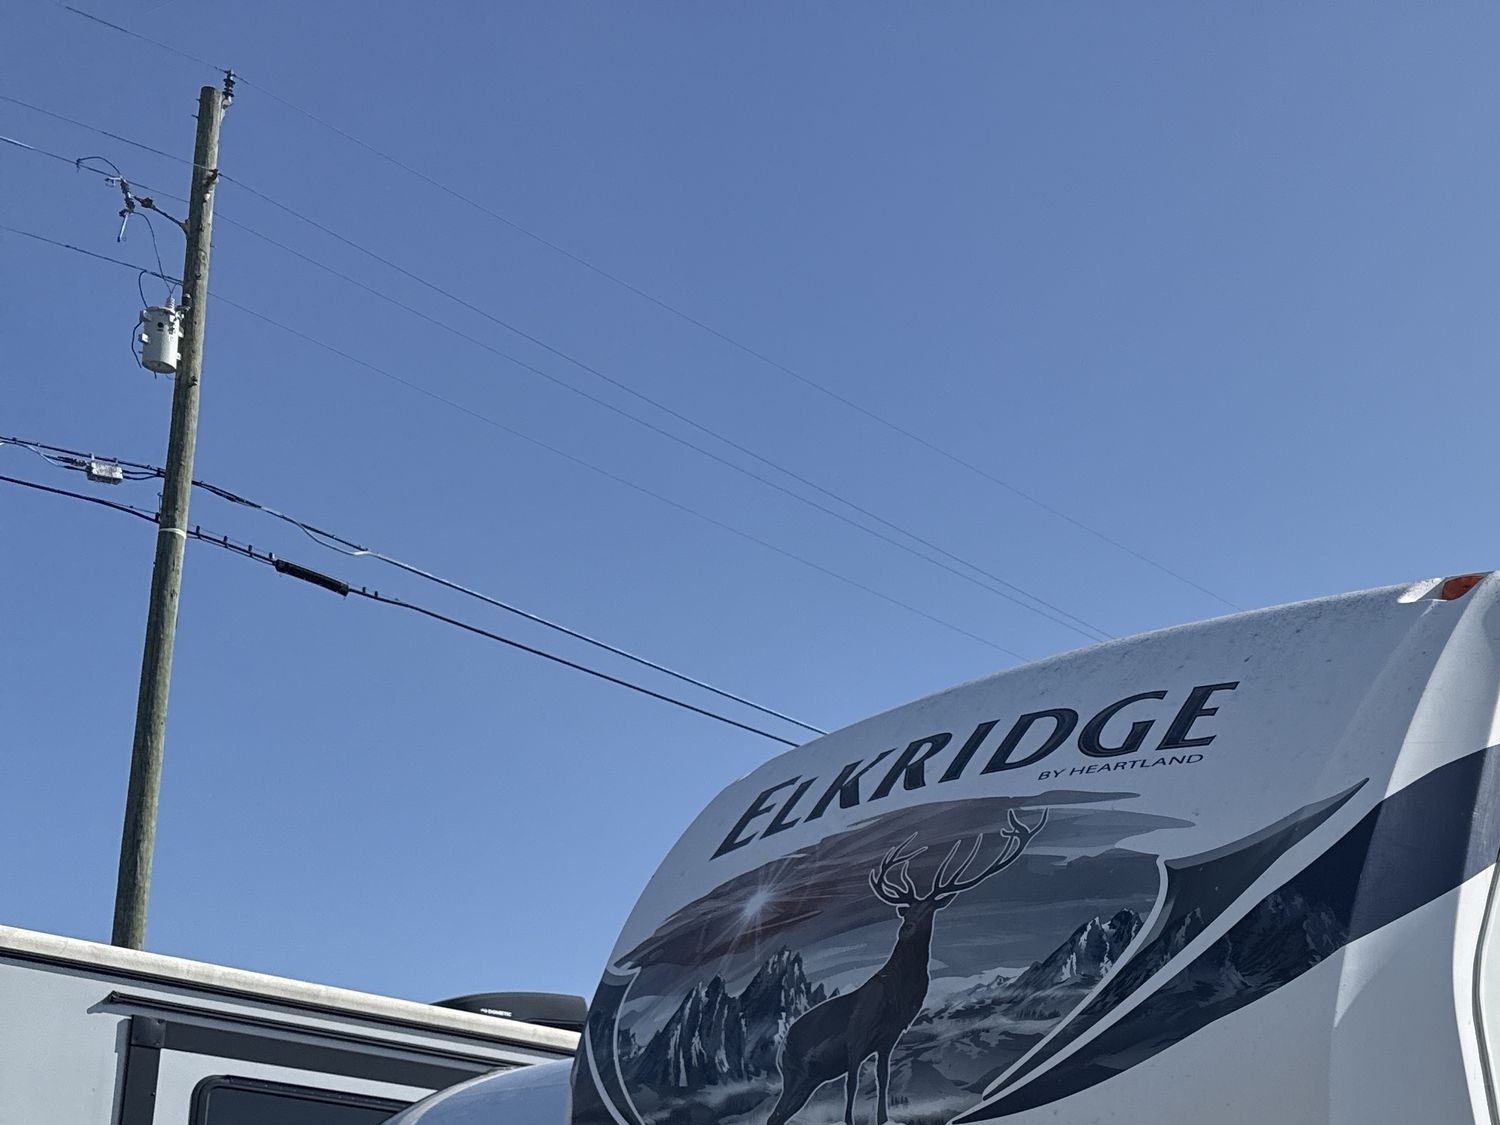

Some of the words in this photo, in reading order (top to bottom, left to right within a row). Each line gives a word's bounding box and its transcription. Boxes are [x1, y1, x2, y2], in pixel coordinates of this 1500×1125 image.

[710, 681, 1240, 860] ELKRIDGE
[1038, 768, 1066, 780] BY
[1069, 754, 1204, 776] HEARTLAND
